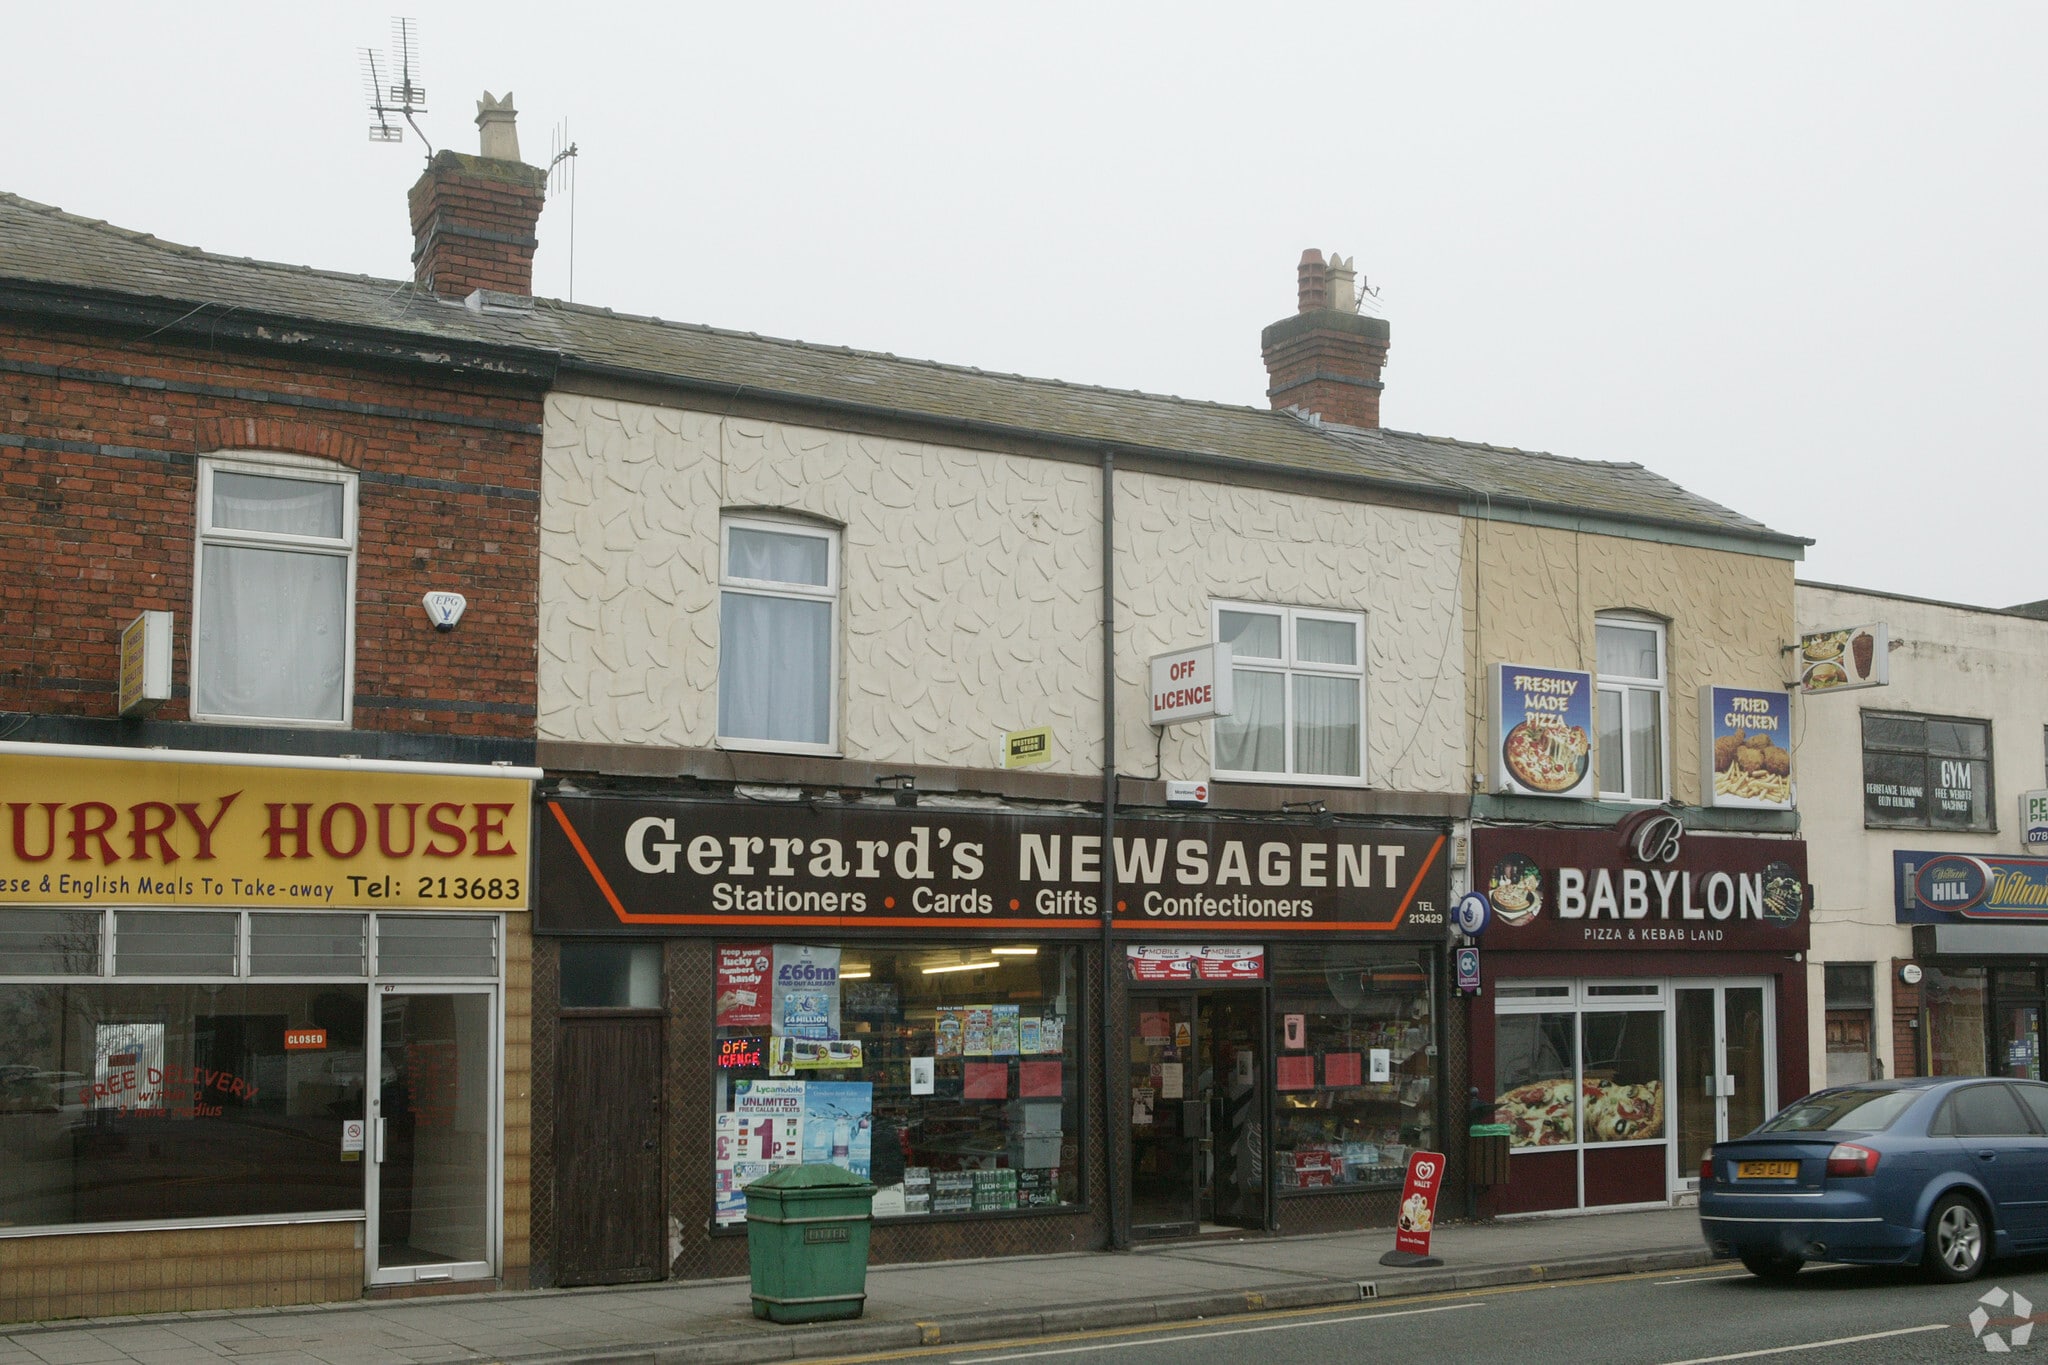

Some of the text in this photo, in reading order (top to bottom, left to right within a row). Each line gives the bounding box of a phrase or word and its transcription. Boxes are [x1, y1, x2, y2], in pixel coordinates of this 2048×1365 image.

[434, 595, 460, 608] EPG
[1170, 660, 1195, 681] OFF
[1513, 675, 1578, 696] FRESHLY
[1154, 684, 1212, 711] LICENCE
[1525, 693, 1569, 712] MADE
[1732, 697, 1769, 713] FRIED
[1525, 711, 1567, 728] PIZZA
[1725, 712, 1778, 730] CHICKEN
[1941, 760, 1971, 789] GYM
[0, 789, 243, 867] URRY
[261, 800, 518, 861] HOUSE
[1638, 815, 1684, 864] B
[625, 816, 985, 881] Gerrard's
[1020, 833, 1405, 889] NEWSAGENT
[40, 874, 50, 893] &
[59, 874, 129, 899] English
[138, 876, 193, 895] Meals
[201, 878, 224, 895] To
[232, 878, 334, 902] Take-away
[347, 875, 520, 900] Tel: 213683
[1559, 867, 1764, 920] BABYLON
[1932, 881, 1969, 901] HILL
[712, 883, 1313, 918] Stationers Cards Gifts Confectioners
[1417, 901, 1435, 911] TEL
[1409, 913, 1442, 924] 213429
[1584, 928, 1723, 941] PIZZA & KEBAB LAND
[721, 949, 761, 958] Keep your
[723, 957, 752, 967] lucky
[720, 966, 754, 974] numbers
[729, 973, 762, 984] handy
[779, 964, 836, 980] £66m
[288, 1034, 323, 1044] CLOSED
[722, 1041, 748, 1054] OFF
[79, 1064, 260, 1109] FREE DELIVERY
[756, 1085, 803, 1095] Lycamobile
[138, 1089, 187, 1102] within
[743, 1097, 798, 1107] UNLIMITED
[117, 1103, 223, 1118] 3 mile radius
[809, 1228, 847, 1240] LITTER
